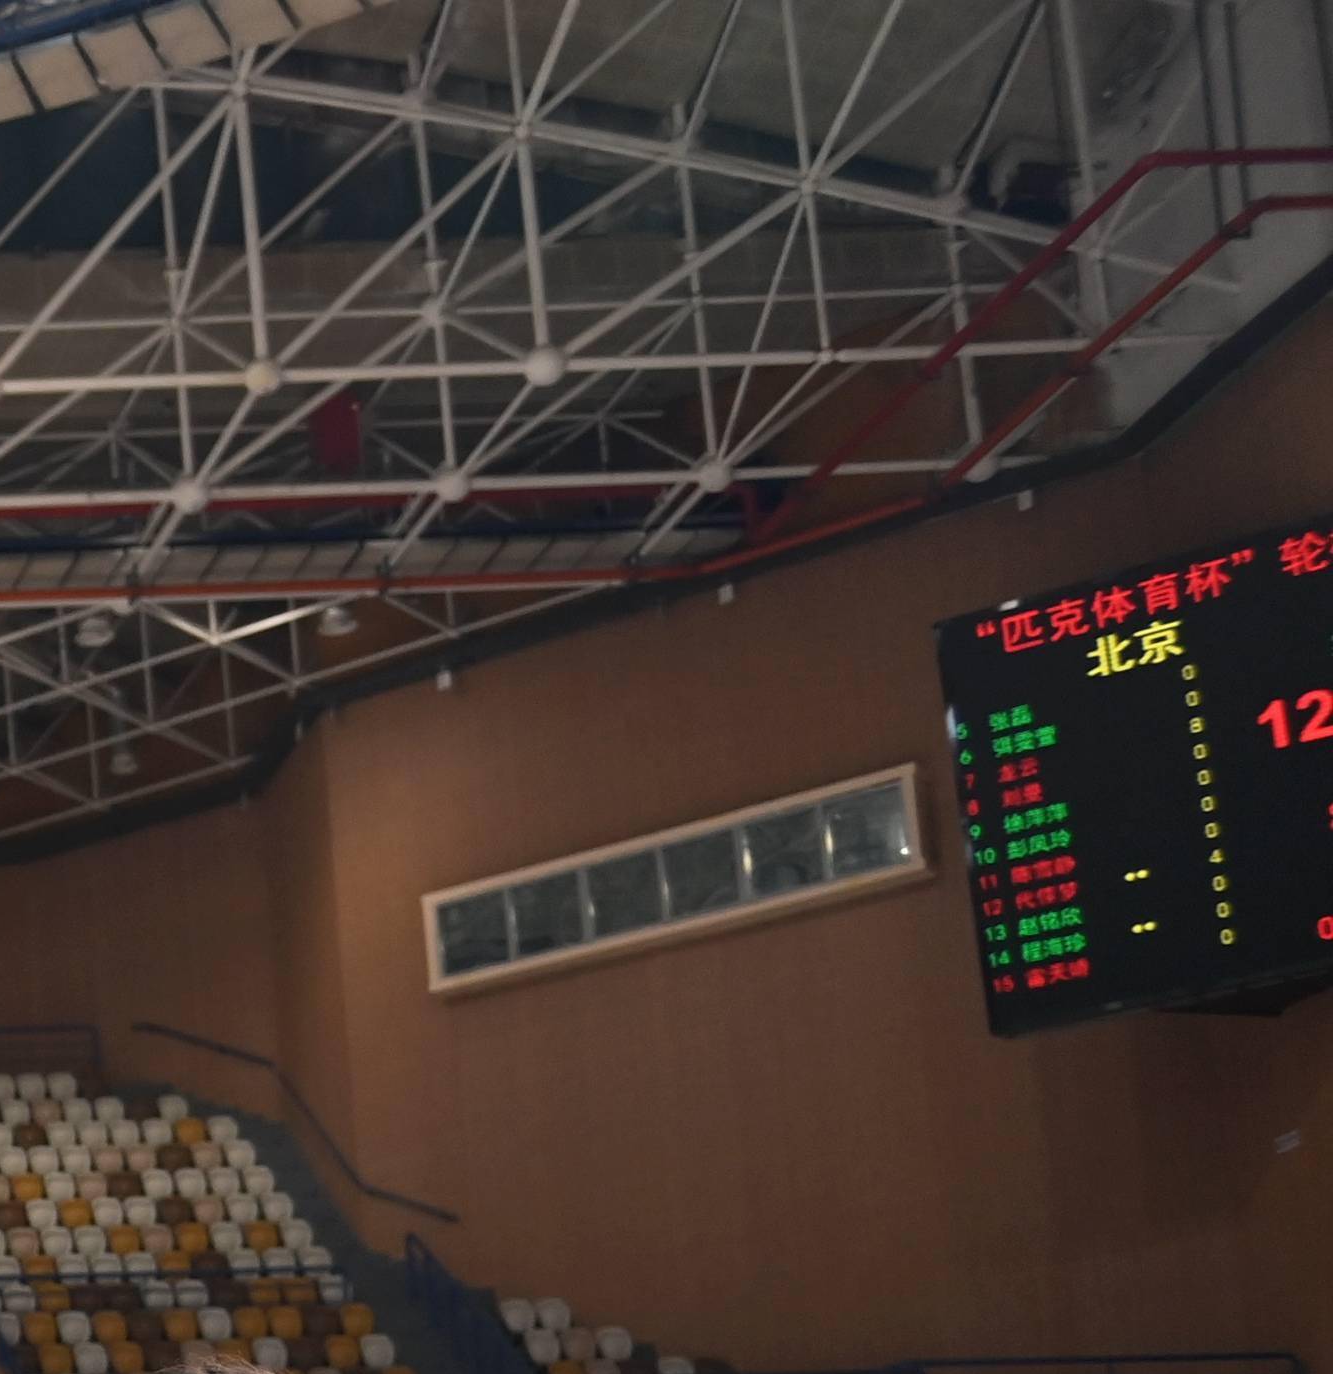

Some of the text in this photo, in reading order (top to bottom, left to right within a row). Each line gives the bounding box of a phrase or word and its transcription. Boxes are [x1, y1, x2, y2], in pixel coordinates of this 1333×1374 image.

[1087, 620, 1184, 677] 北京
[1257, 688, 1333, 749] 12
[960, 750, 973, 765] 6
[969, 824, 982, 840] 9
[975, 847, 997, 865] 10
[986, 924, 1007, 941] 13
[990, 950, 1011, 967] 14
